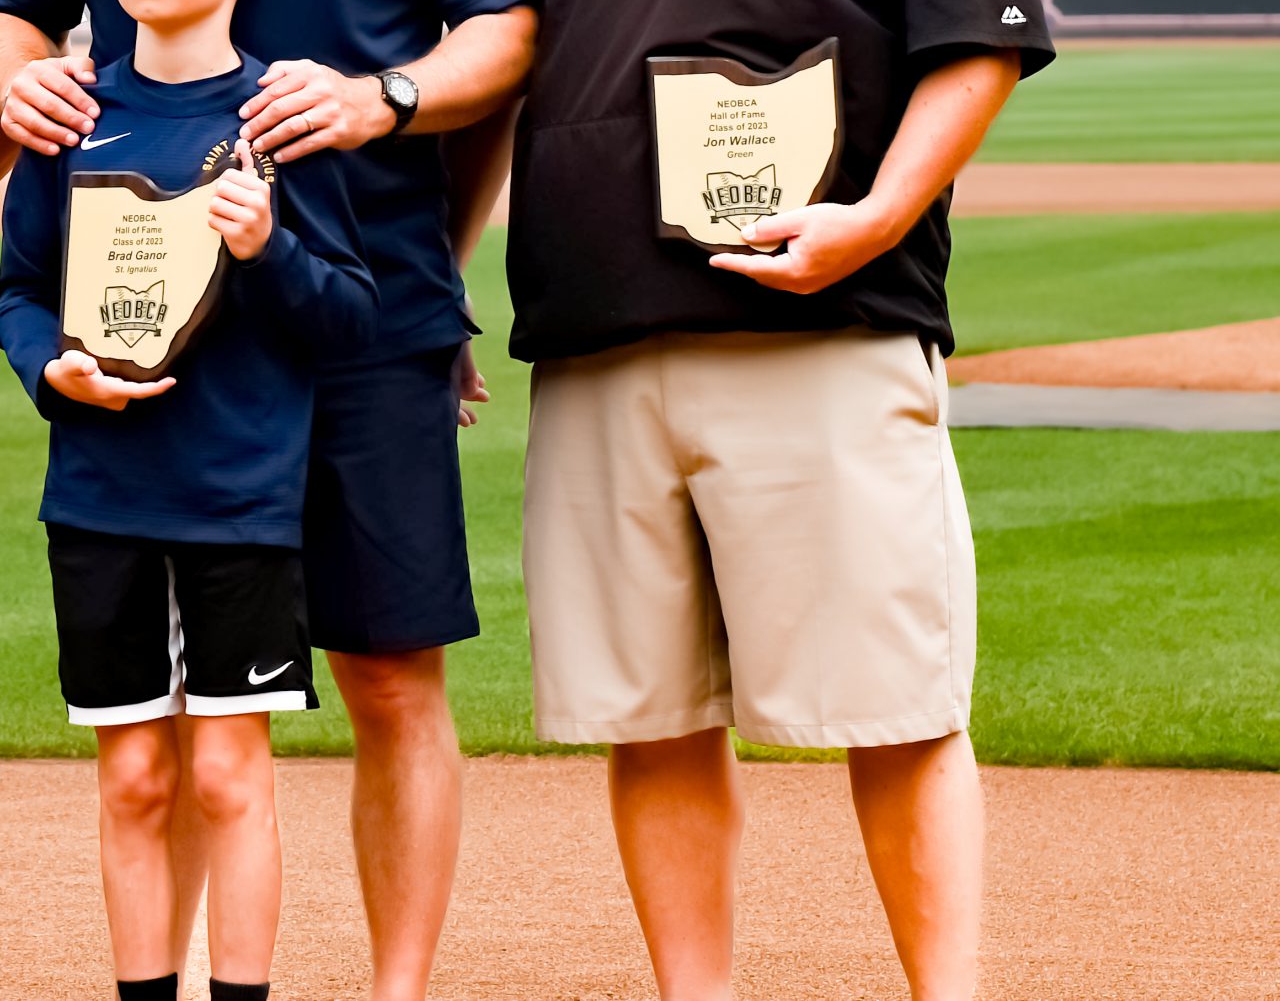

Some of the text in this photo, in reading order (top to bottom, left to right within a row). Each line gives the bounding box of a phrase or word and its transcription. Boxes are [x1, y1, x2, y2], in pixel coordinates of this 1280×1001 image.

[717, 99, 757, 108] NEOBCA
[710, 111, 766, 120] Hall of Fame
[708, 122, 768, 132] Class of 2023
[703, 135, 776, 148] Jon Wallace
[202, 140, 229, 171] SAINT
[727, 151, 754, 159] Green
[702, 185, 782, 210] NEOBCA
[122, 214, 157, 223] NEOBCA
[115, 226, 163, 234] Hall of Fame
[112, 237, 164, 246] Class of 2023
[108, 250, 168, 261] Brad Ganor
[115, 265, 158, 274] St. Ignatius
[99, 300, 168, 323] NEOBCA
